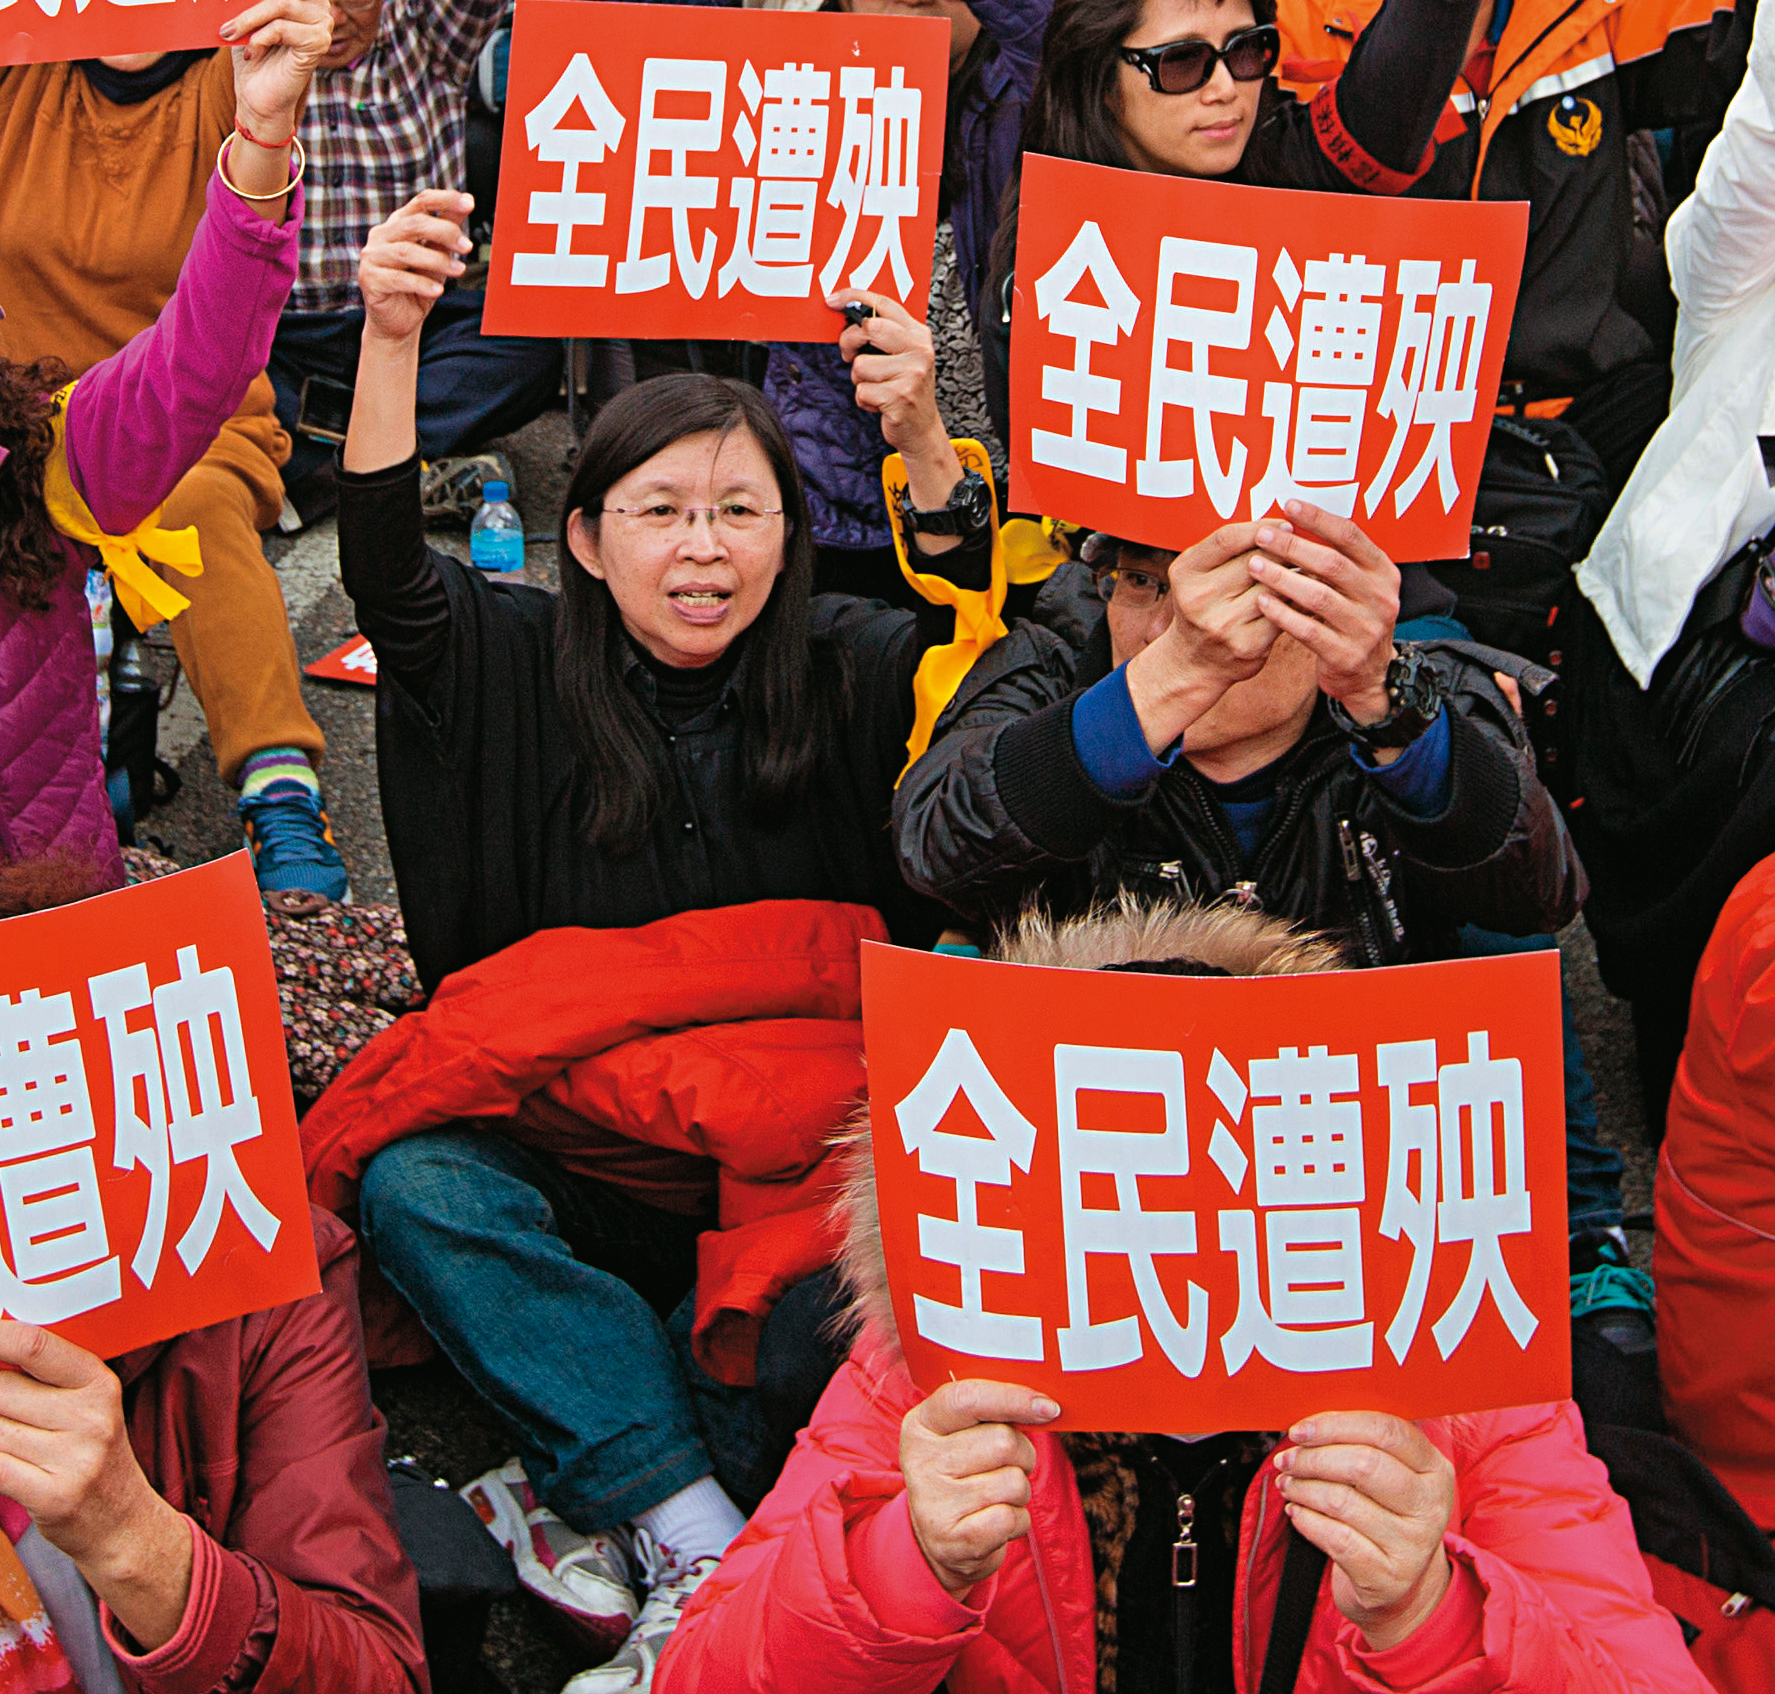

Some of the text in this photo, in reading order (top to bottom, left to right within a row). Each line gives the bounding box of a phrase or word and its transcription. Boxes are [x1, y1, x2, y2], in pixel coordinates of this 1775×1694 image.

[510, 53, 923, 302] 全民遭殃
[1030, 220, 1494, 520] 全民遭殃
[893, 1028, 1540, 1379] 全民遭殃
